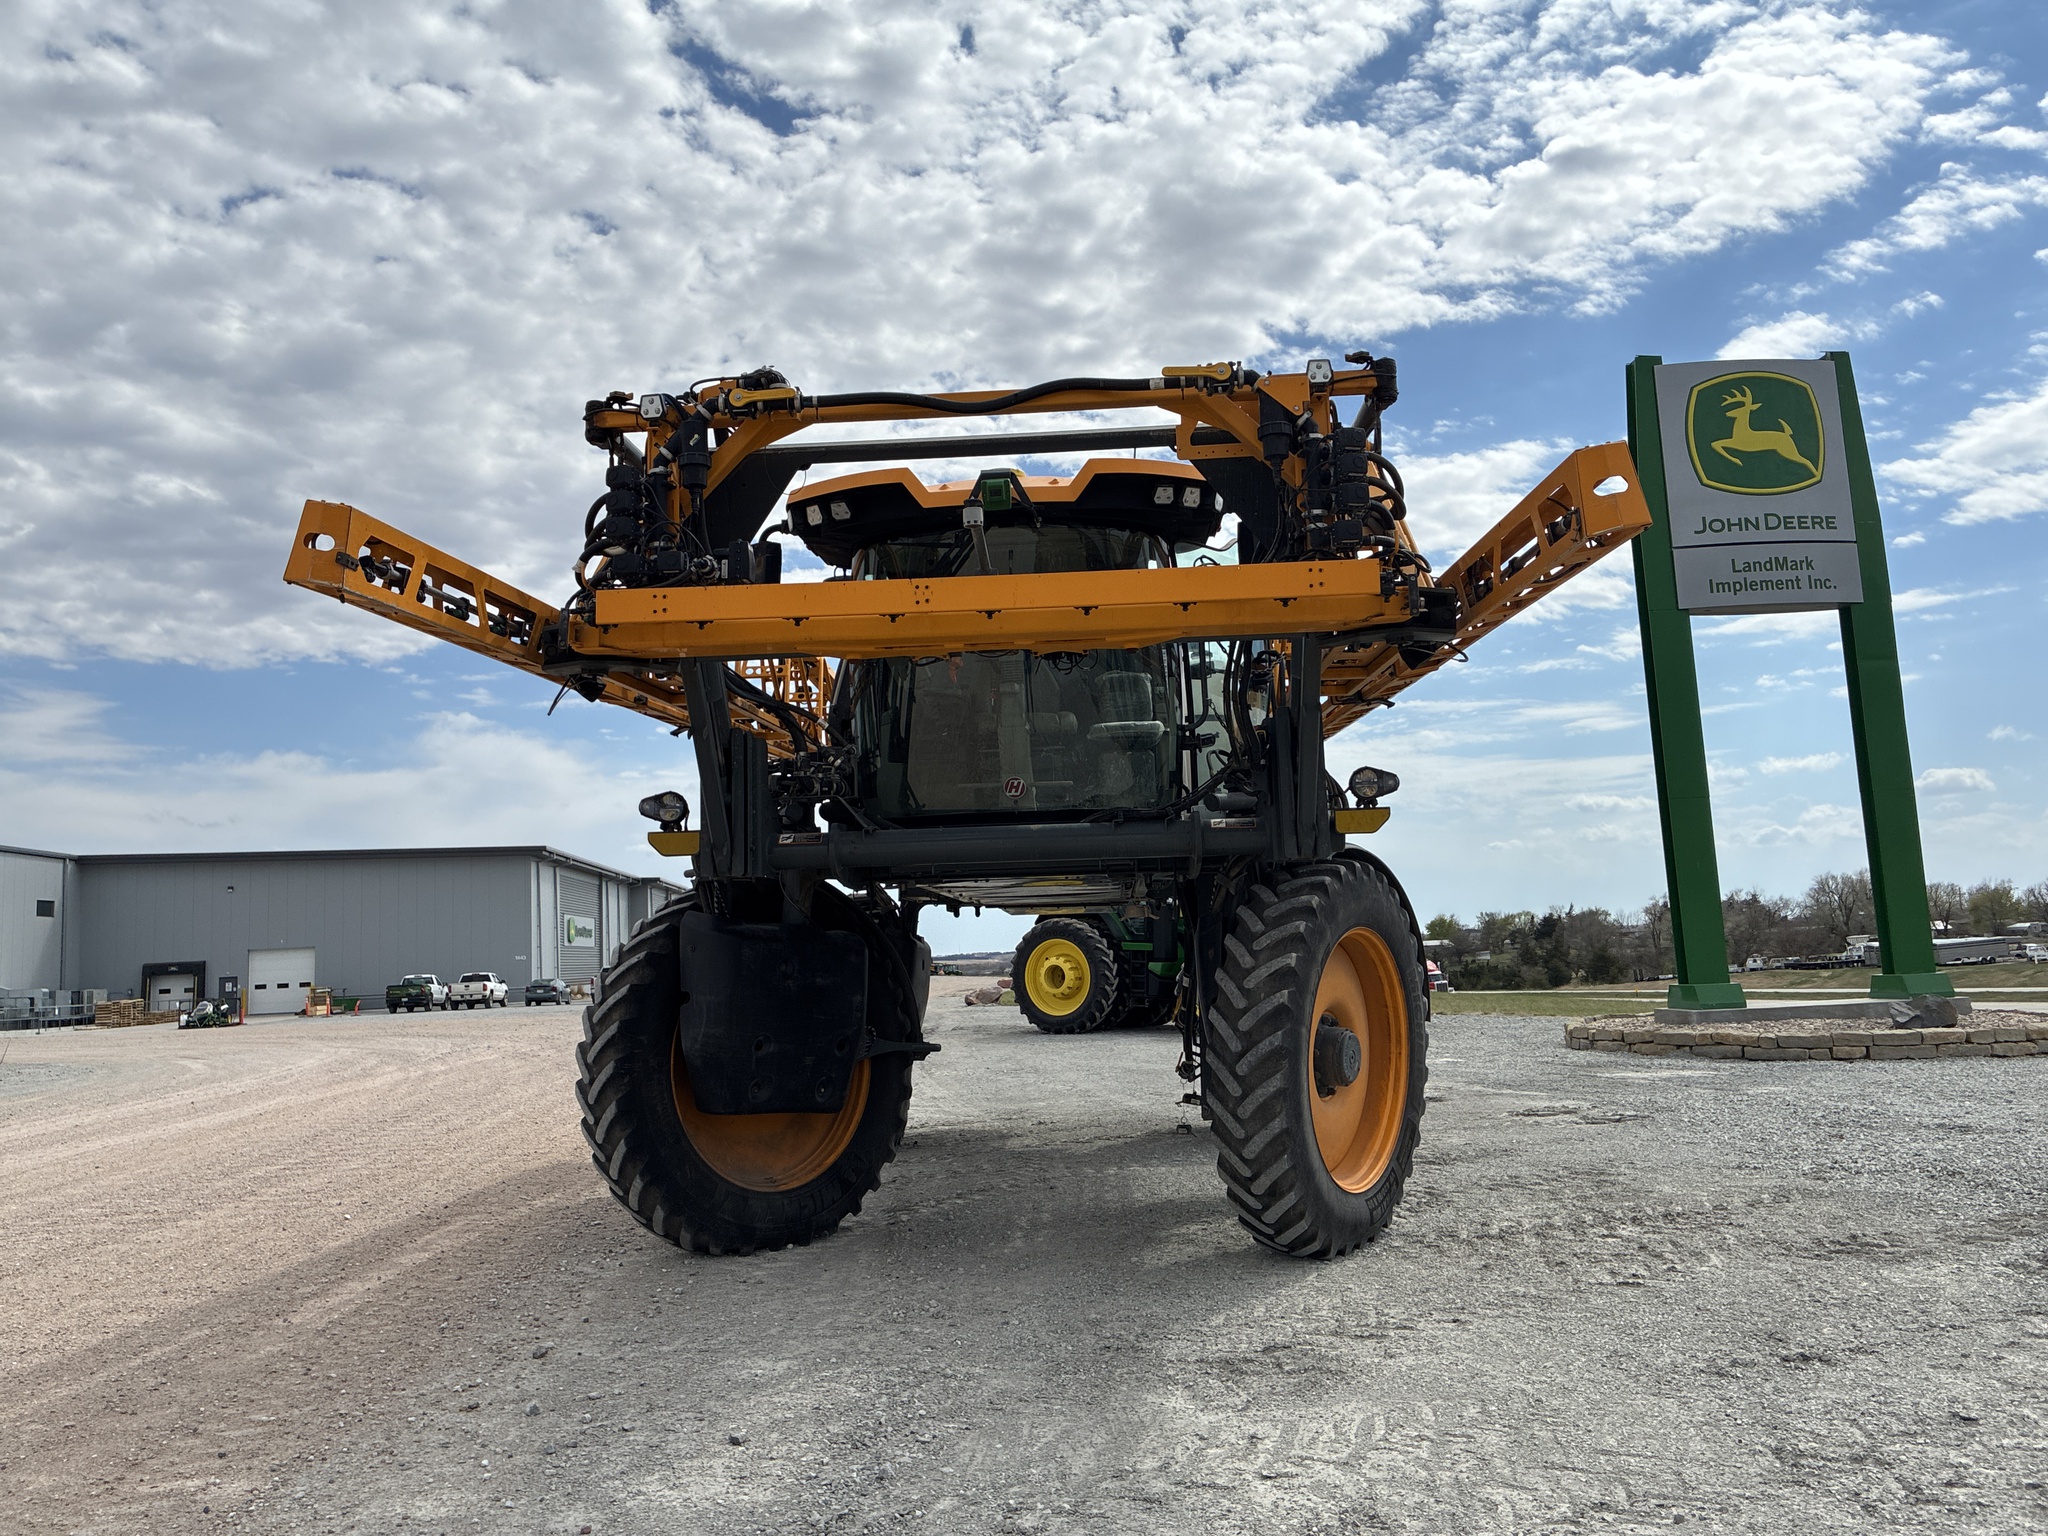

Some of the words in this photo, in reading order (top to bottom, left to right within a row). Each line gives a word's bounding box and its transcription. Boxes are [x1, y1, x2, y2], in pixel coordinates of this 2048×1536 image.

[1694, 516, 1760, 535] JOHN
[1763, 512, 1838, 531] DEERE
[1731, 556, 1815, 573] LandMark
[1708, 575, 1802, 596] Implement
[1808, 574, 1837, 590] Inc.
